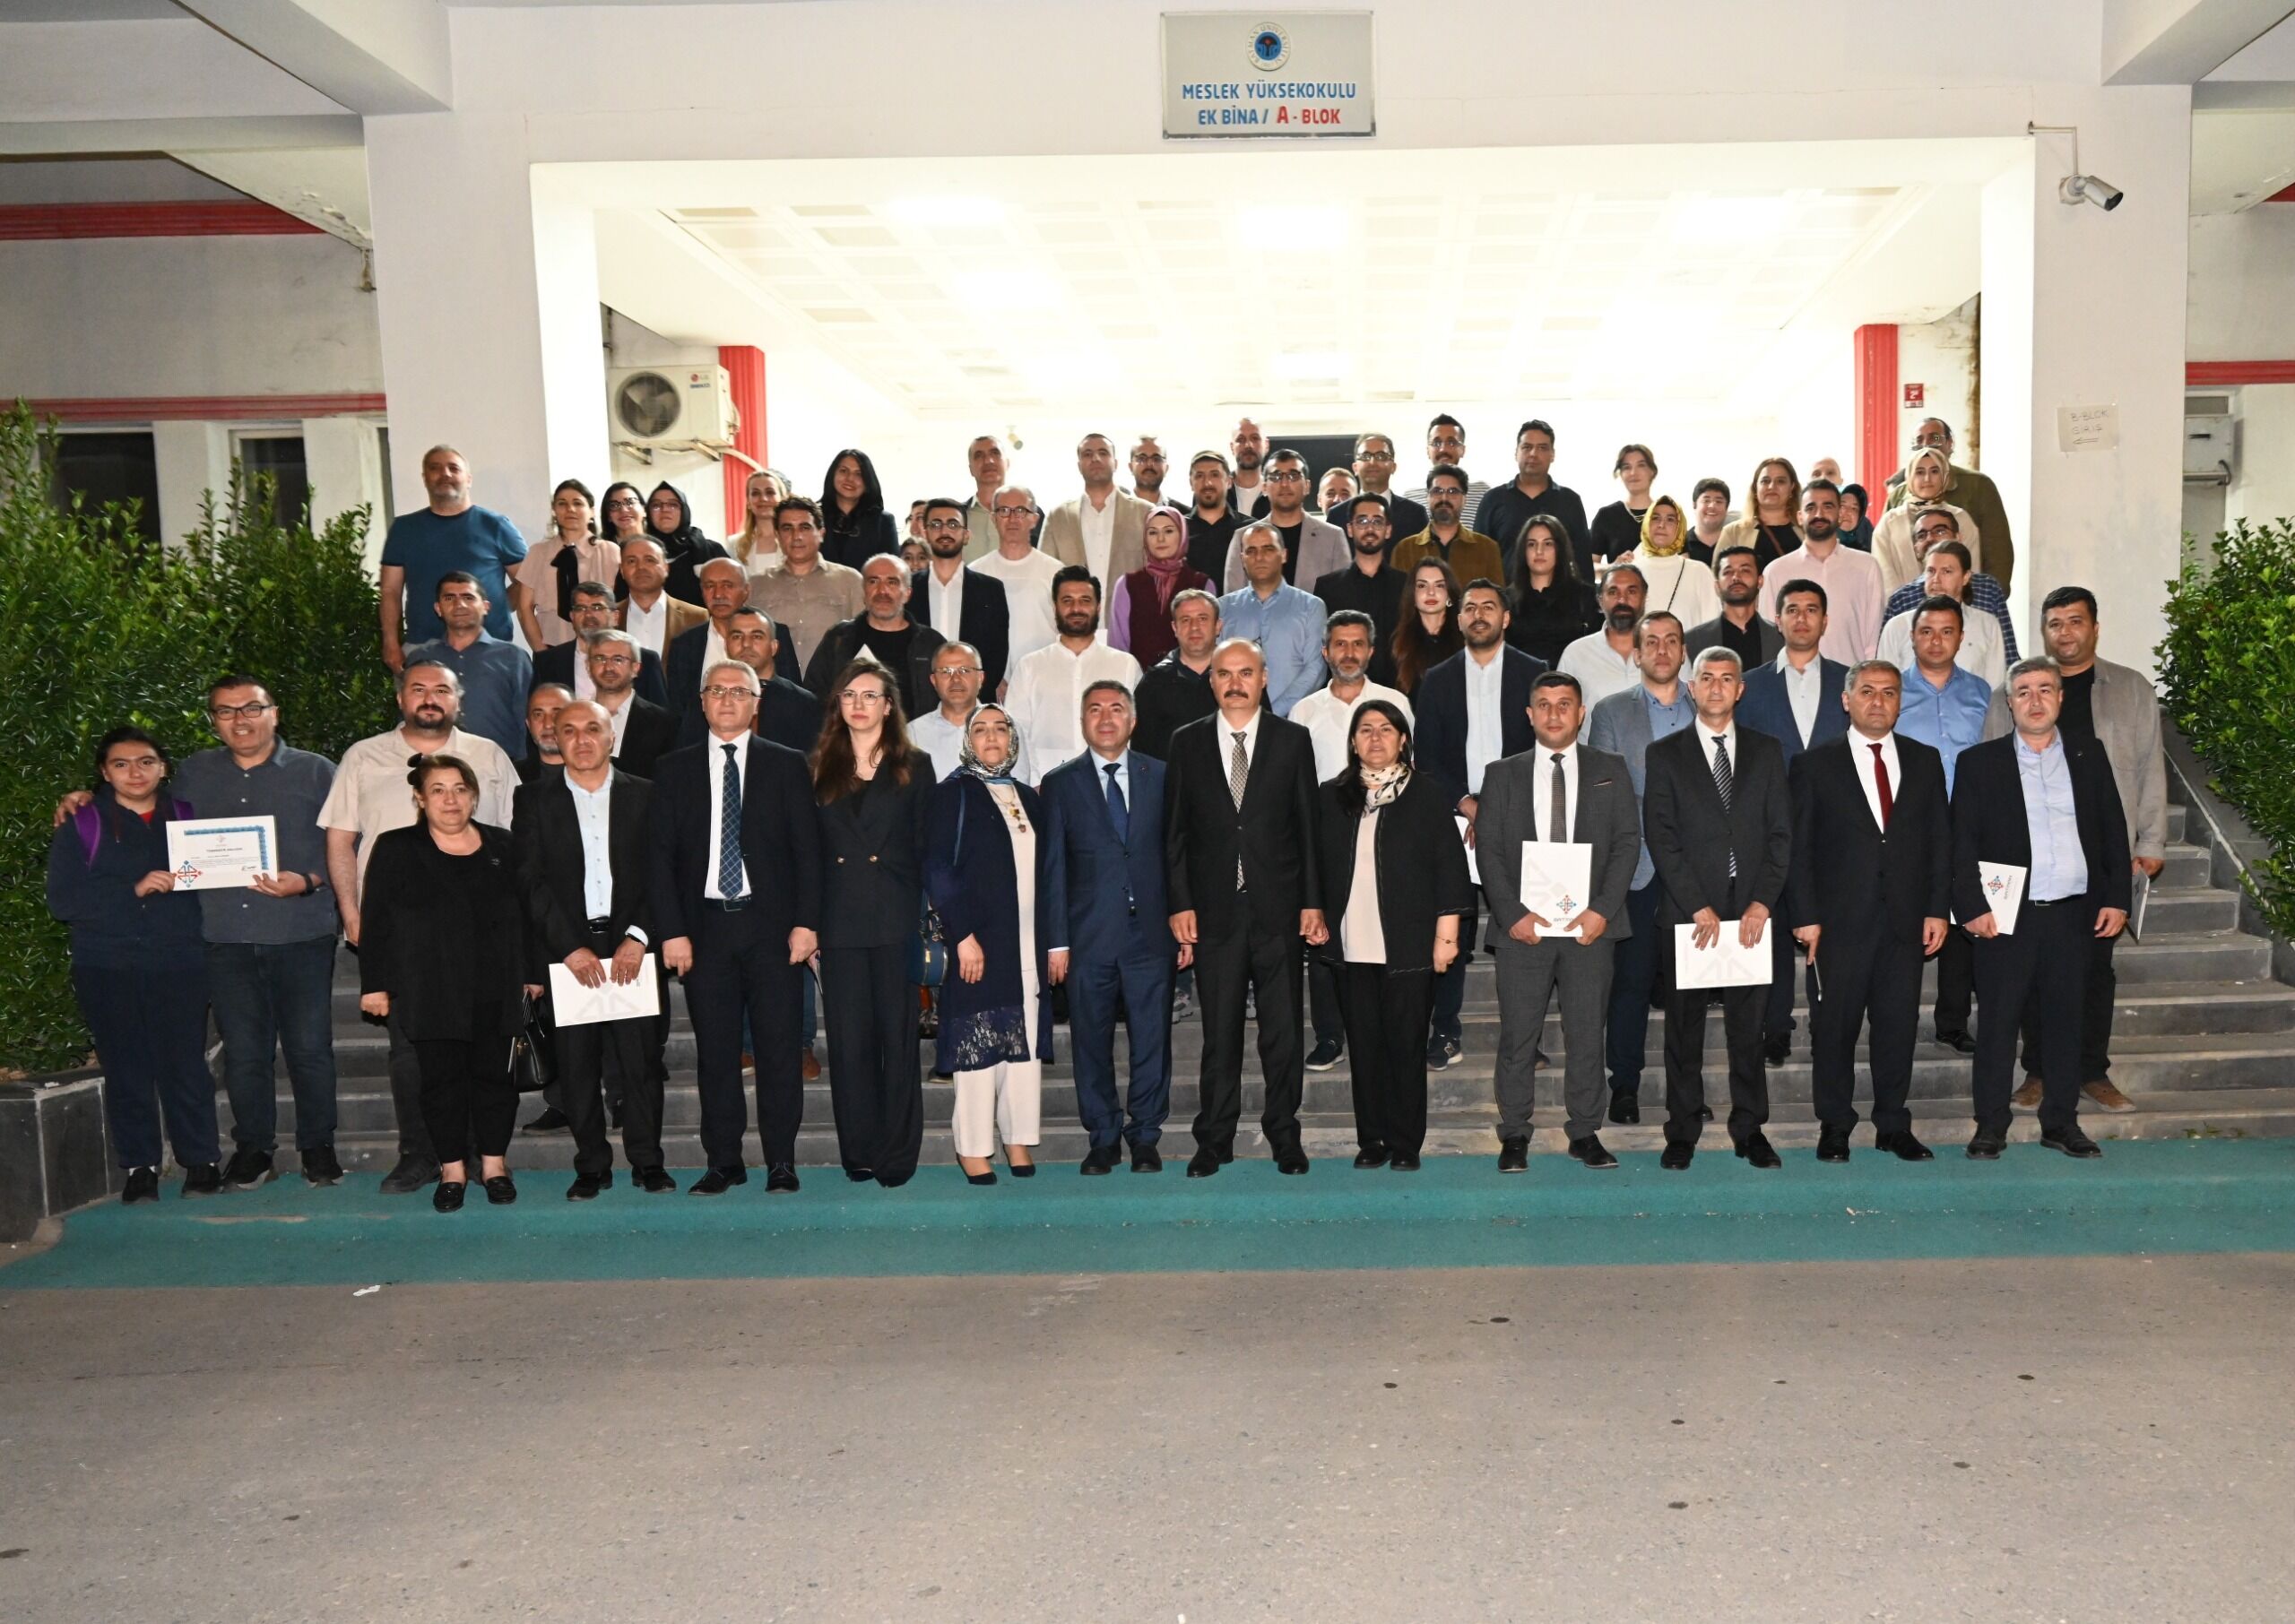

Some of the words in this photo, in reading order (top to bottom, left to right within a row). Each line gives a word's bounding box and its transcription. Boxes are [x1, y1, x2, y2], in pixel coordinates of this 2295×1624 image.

[1182, 83, 1240, 99] MESLEK
[1246, 79, 1356, 99] YÜKSEKOKULU
[1198, 108, 1217, 125] EK
